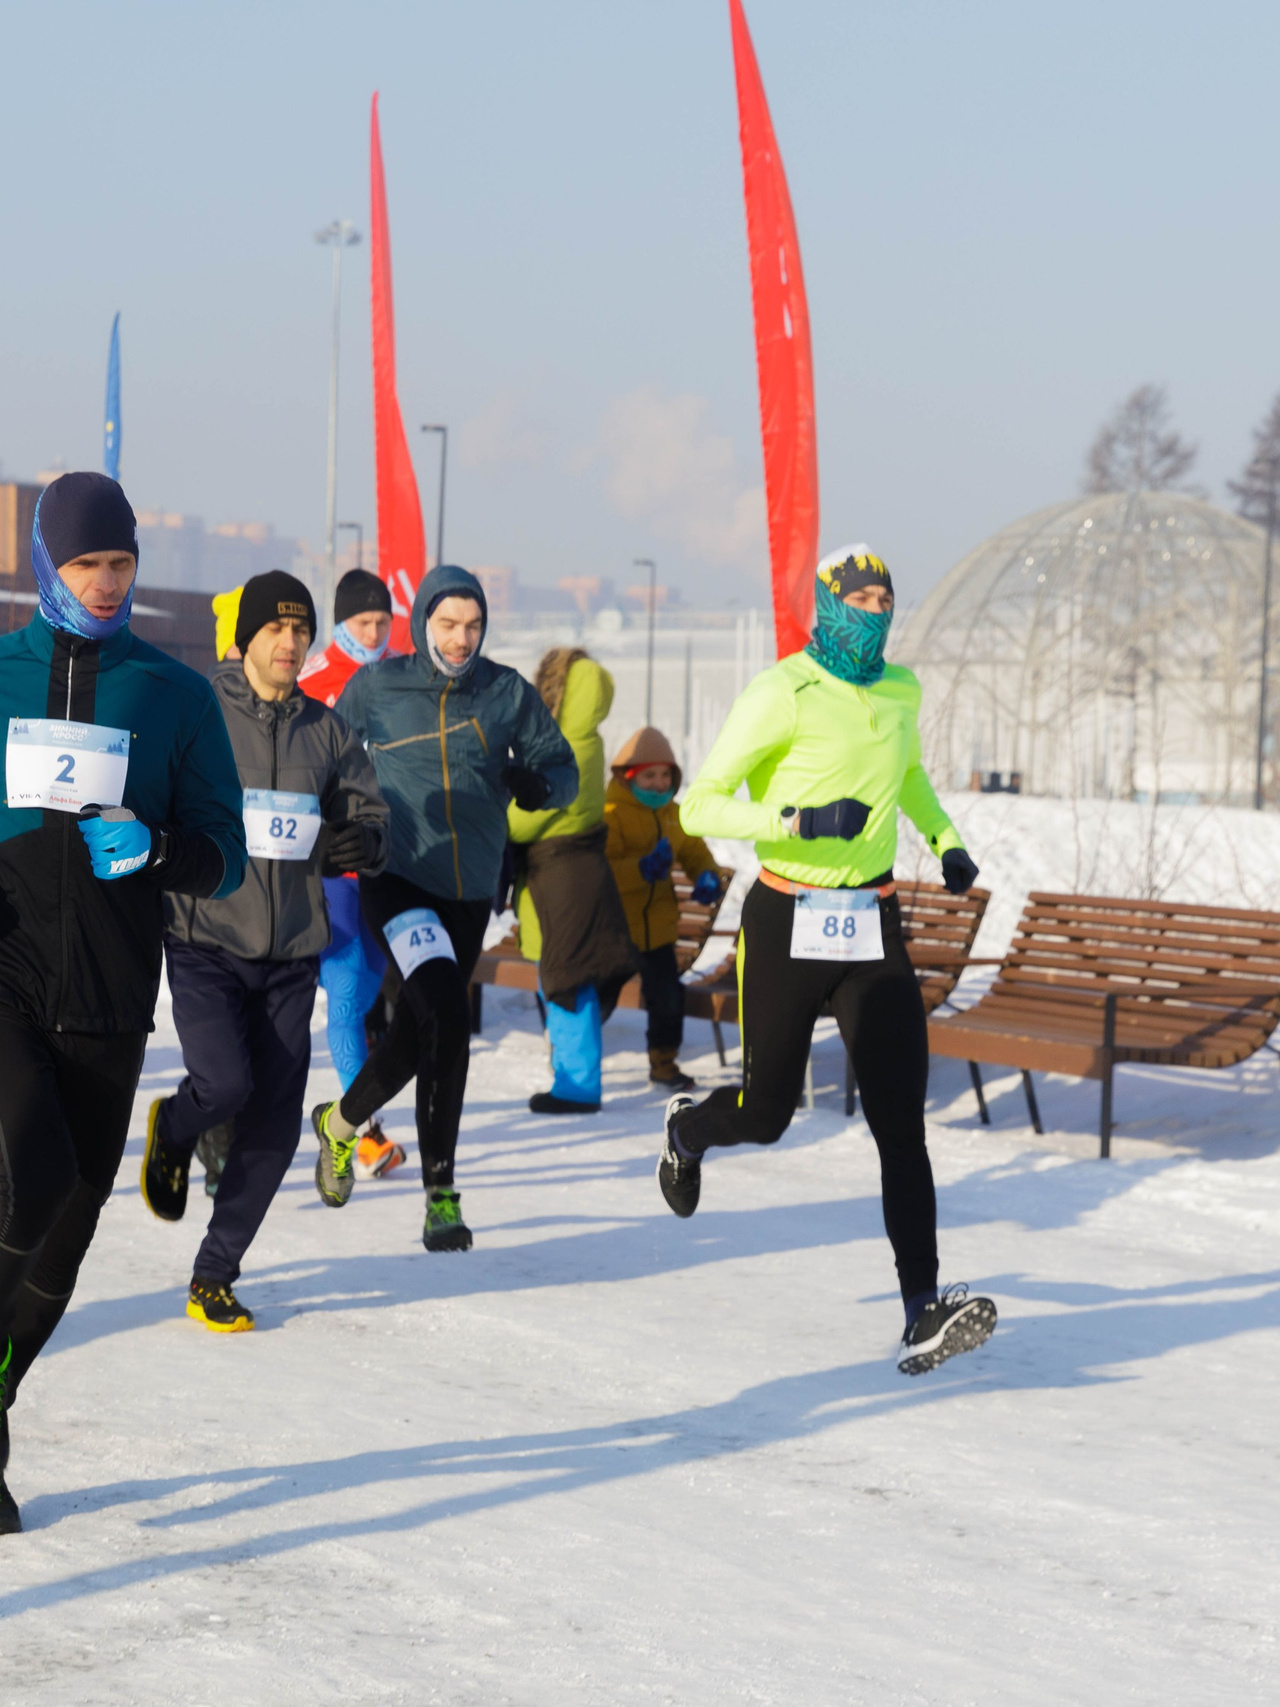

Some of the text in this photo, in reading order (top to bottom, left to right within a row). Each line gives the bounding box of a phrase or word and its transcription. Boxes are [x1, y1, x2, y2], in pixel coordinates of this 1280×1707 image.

[55, 753, 76, 784] 2
[269, 816, 298, 840] 82
[410, 926, 436, 948] 43
[823, 916, 856, 938] 88
